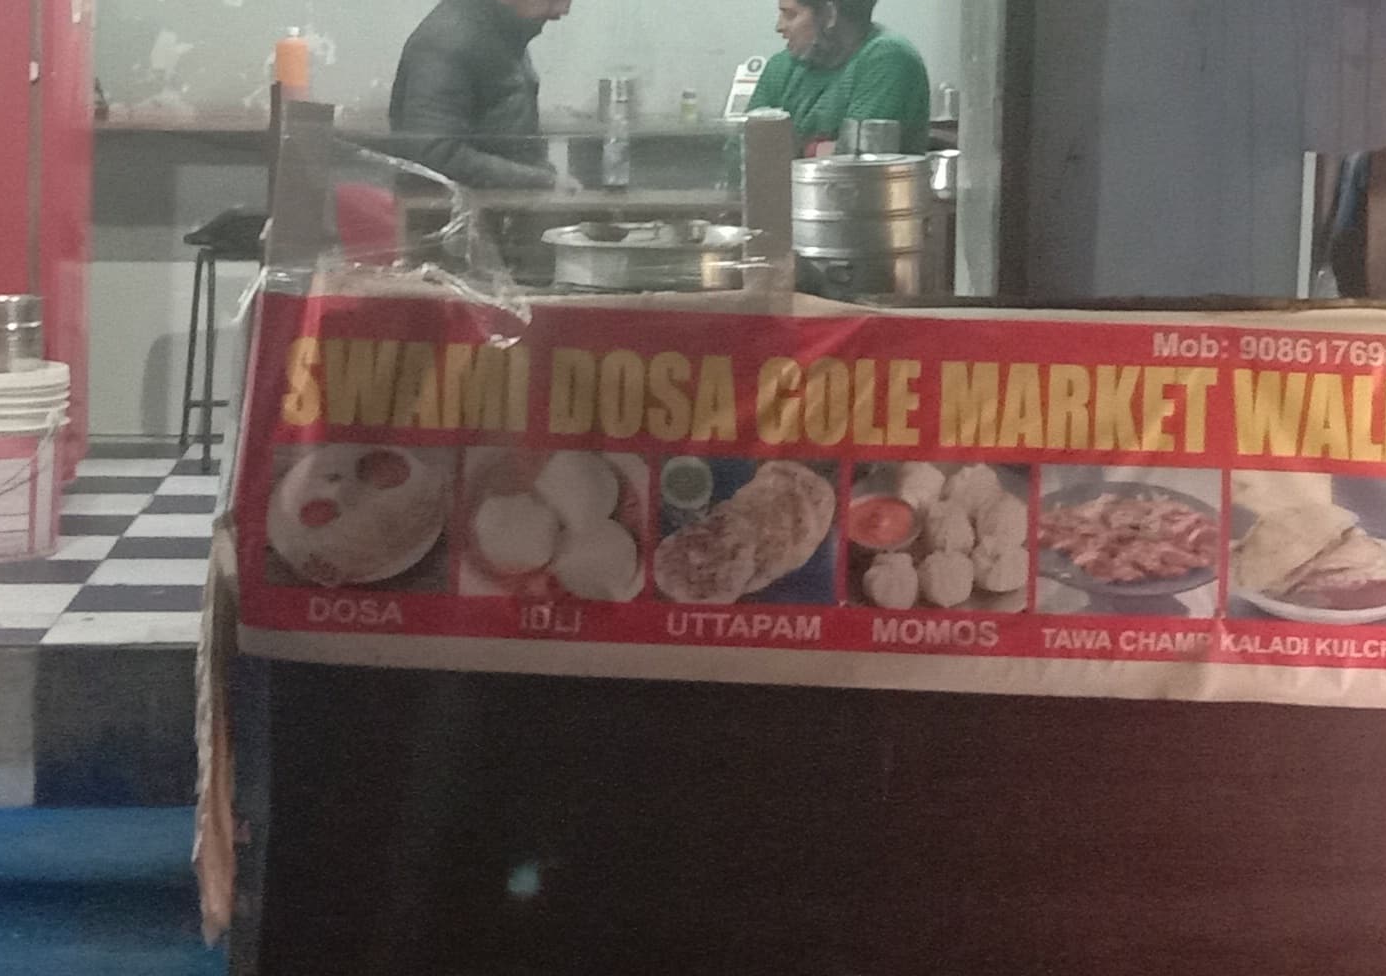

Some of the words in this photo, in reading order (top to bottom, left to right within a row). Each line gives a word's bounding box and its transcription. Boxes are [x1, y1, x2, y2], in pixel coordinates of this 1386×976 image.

[1152, 331, 1229, 360] Mob:
[280, 336, 530, 433] SWAMI
[549, 347, 737, 441] DOSA
[755, 355, 920, 446] GOLE
[939, 360, 1217, 454] MARKET
[307, 597, 403, 626] DOSA
[666, 612, 822, 641] UTTAPAM
[872, 617, 999, 646] MOMOS
[1041, 628, 1111, 650] TAWA
[1219, 632, 1310, 656] KALADI
